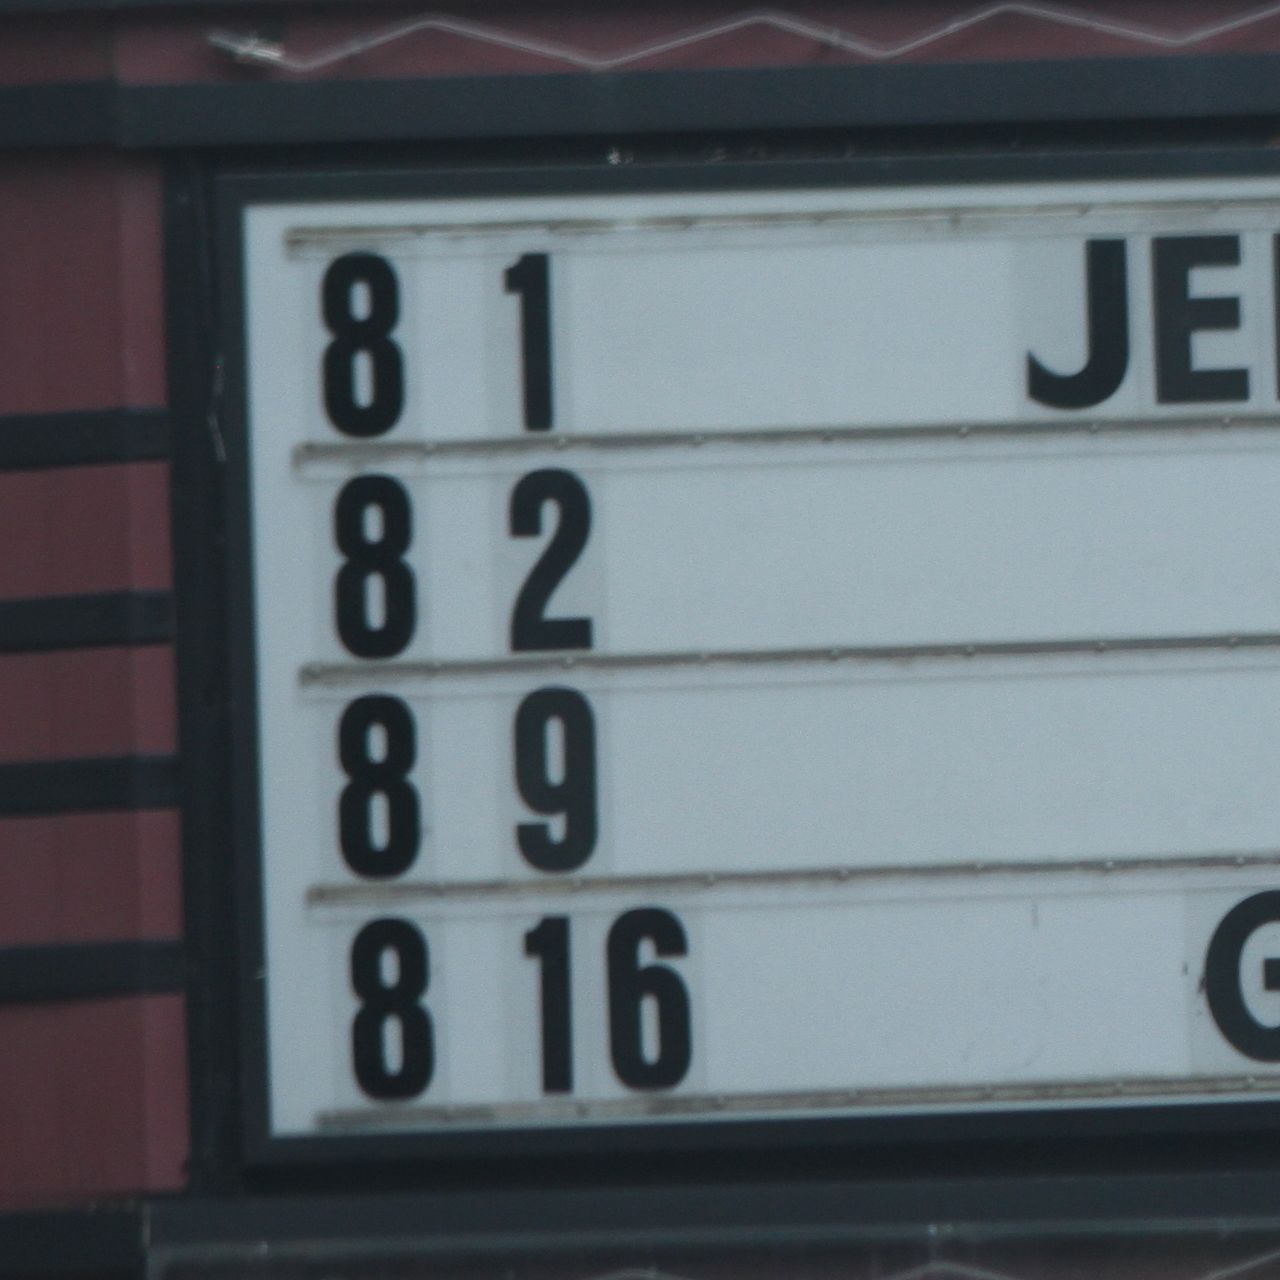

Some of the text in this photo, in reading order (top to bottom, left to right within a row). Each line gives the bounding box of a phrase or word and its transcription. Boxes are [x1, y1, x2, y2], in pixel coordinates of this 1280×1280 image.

[320, 249, 406, 441] 8
[503, 250, 555, 433] 1
[332, 472, 419, 663] 8
[508, 467, 595, 654] 2
[336, 692, 423, 883] 8
[513, 686, 599, 875] 9
[346, 917, 437, 1103] 8
[523, 905, 693, 1097] 16
